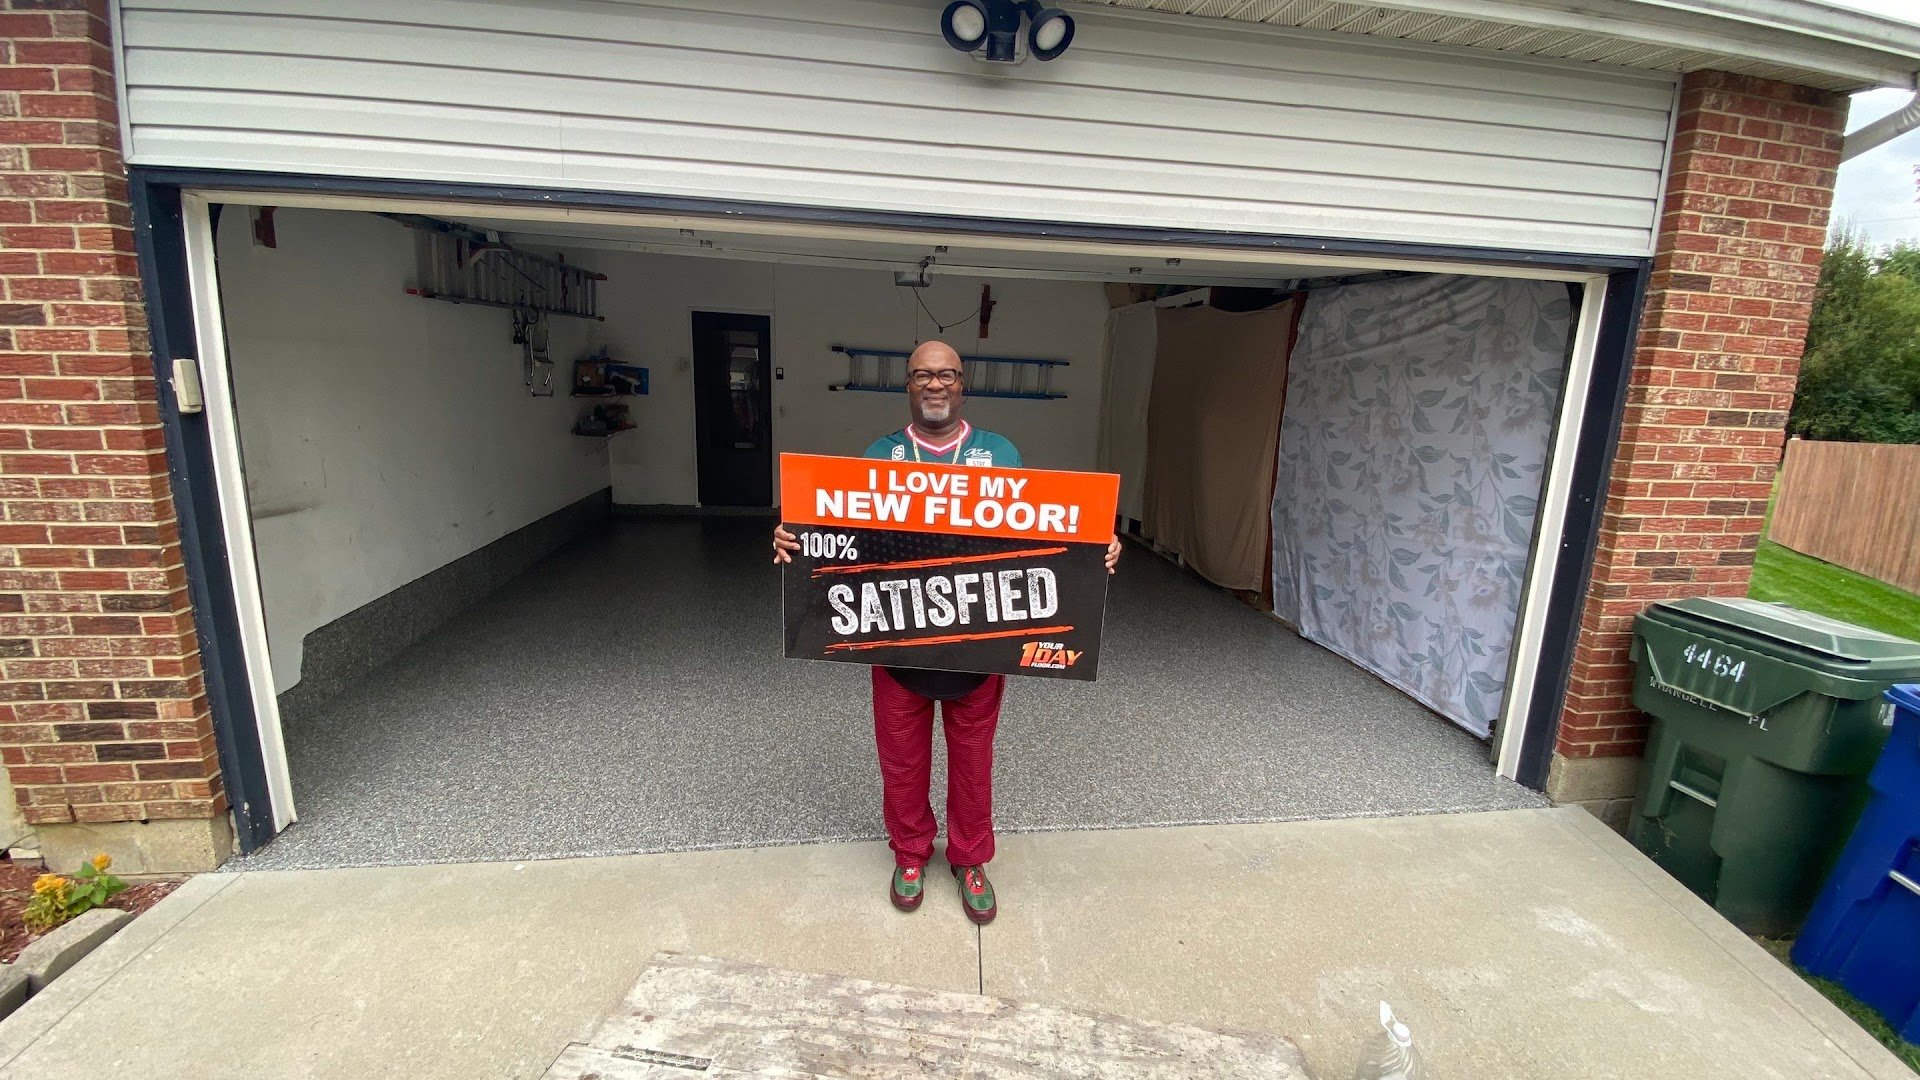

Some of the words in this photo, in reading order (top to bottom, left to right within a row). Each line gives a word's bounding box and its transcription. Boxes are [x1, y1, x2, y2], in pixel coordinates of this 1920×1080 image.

[868, 468, 877, 490] I
[888, 470, 969, 495] LOVE
[980, 476, 1028, 499] MY
[815, 488, 911, 522] NEW
[924, 496, 1080, 534] FLOOR!
[800, 532, 858, 561] 100%
[827, 567, 1059, 635] SATISFIED
[1033, 648, 1084, 666] DAY
[1038, 641, 1064, 650] YOUR
[1030, 662, 1066, 670] FLOOR.COM
[1748, 715, 1769, 732] PL
